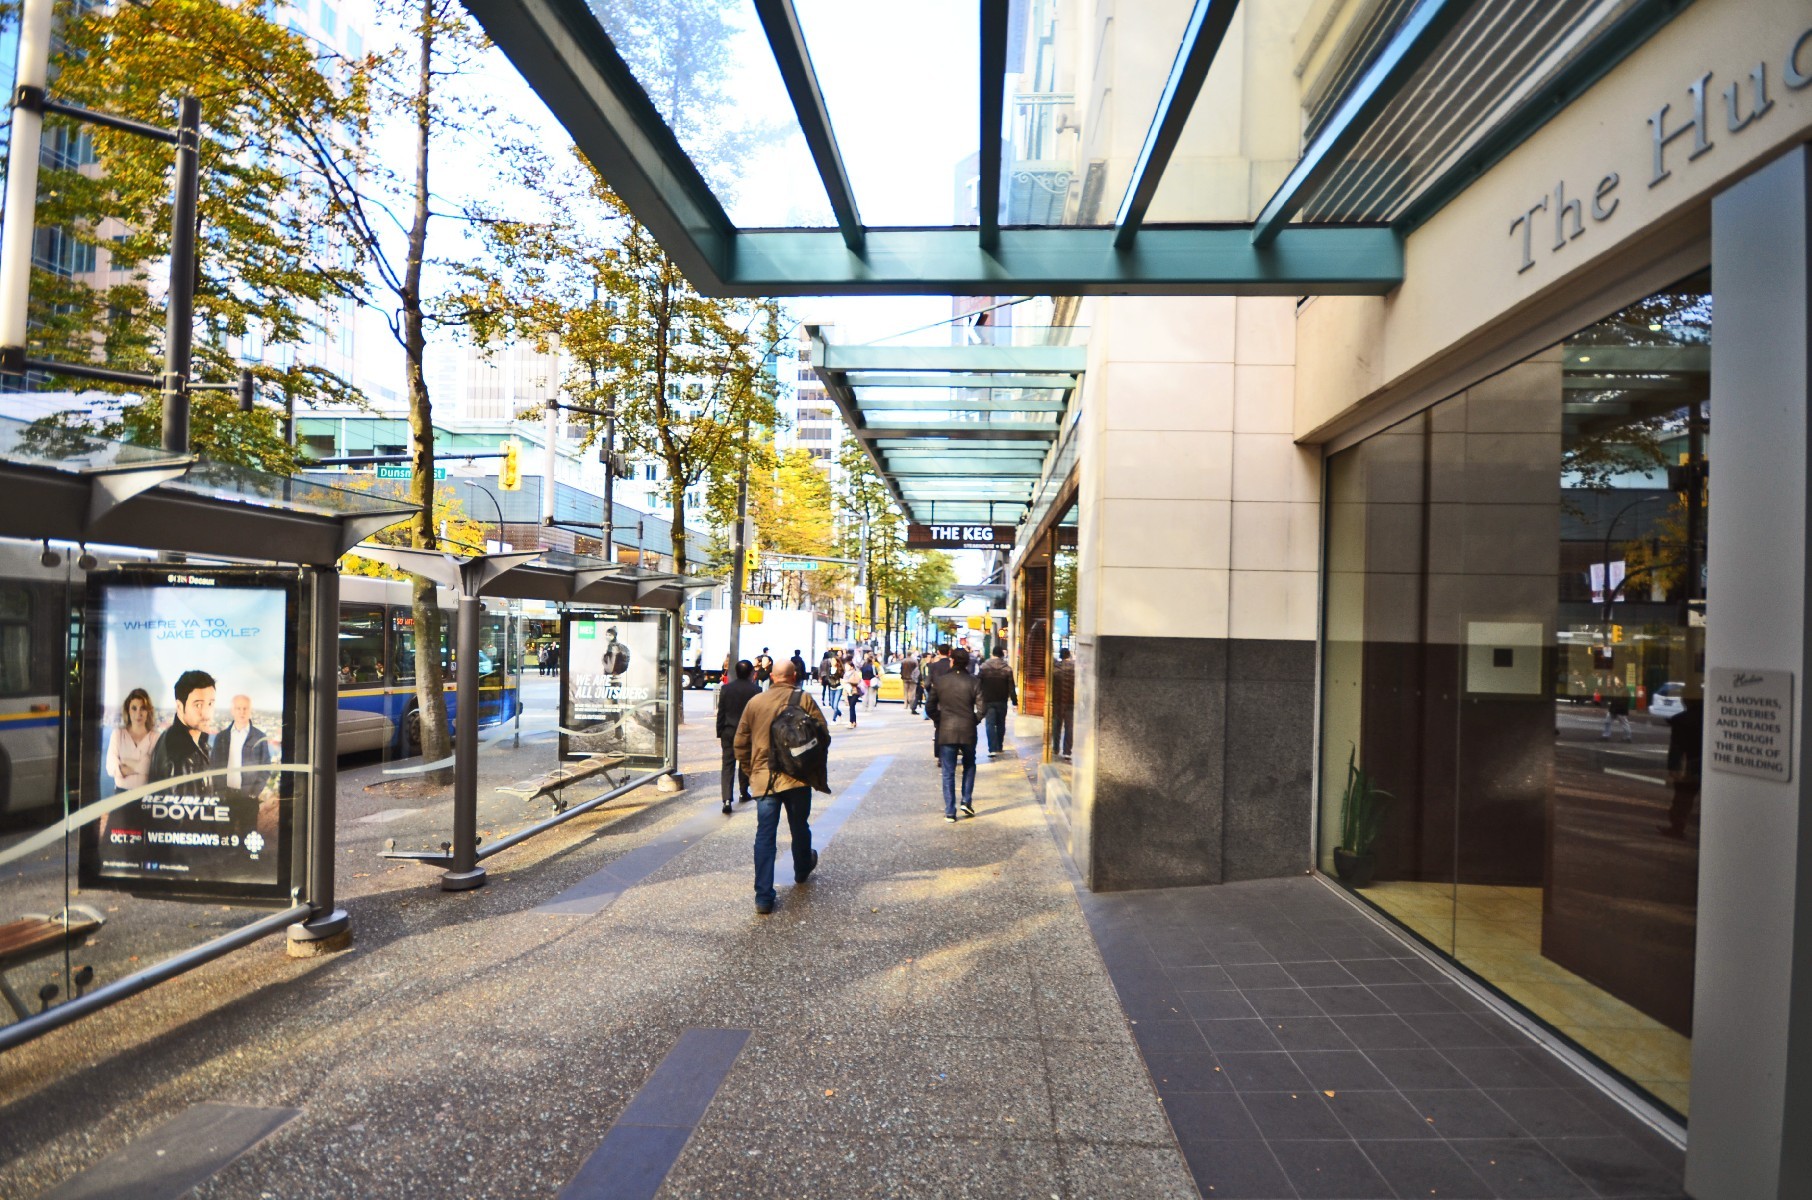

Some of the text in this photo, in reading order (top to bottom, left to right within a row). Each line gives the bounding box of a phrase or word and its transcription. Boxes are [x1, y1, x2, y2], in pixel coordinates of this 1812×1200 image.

[1509, 172, 1620, 275] The
[930, 526, 993, 541] THE KEG
[124, 618, 228, 630] WHERE YA TO,
[580, 626, 594, 635] MEC
[157, 627, 260, 640] JAKE DOYLE?
[576, 674, 612, 686] WE ARE
[575, 686, 649, 700] ALL OUTSIDERS
[1716, 695, 1782, 709] ALL MOVERS,
[1720, 706, 1776, 720] DELIVERIES
[1716, 718, 1781, 733] AND TRADES
[1722, 730, 1774, 745] THROUGH
[1715, 741, 1781, 758] THE BACK OF
[1713, 752, 1784, 773] THE BUILDING
[141, 794, 220, 806] REPUBLIC
[152, 804, 230, 822] DOYLE
[147, 831, 220, 846] WEDNESDAYS
[220, 836, 230, 846] at
[231, 834, 240, 847] 9
